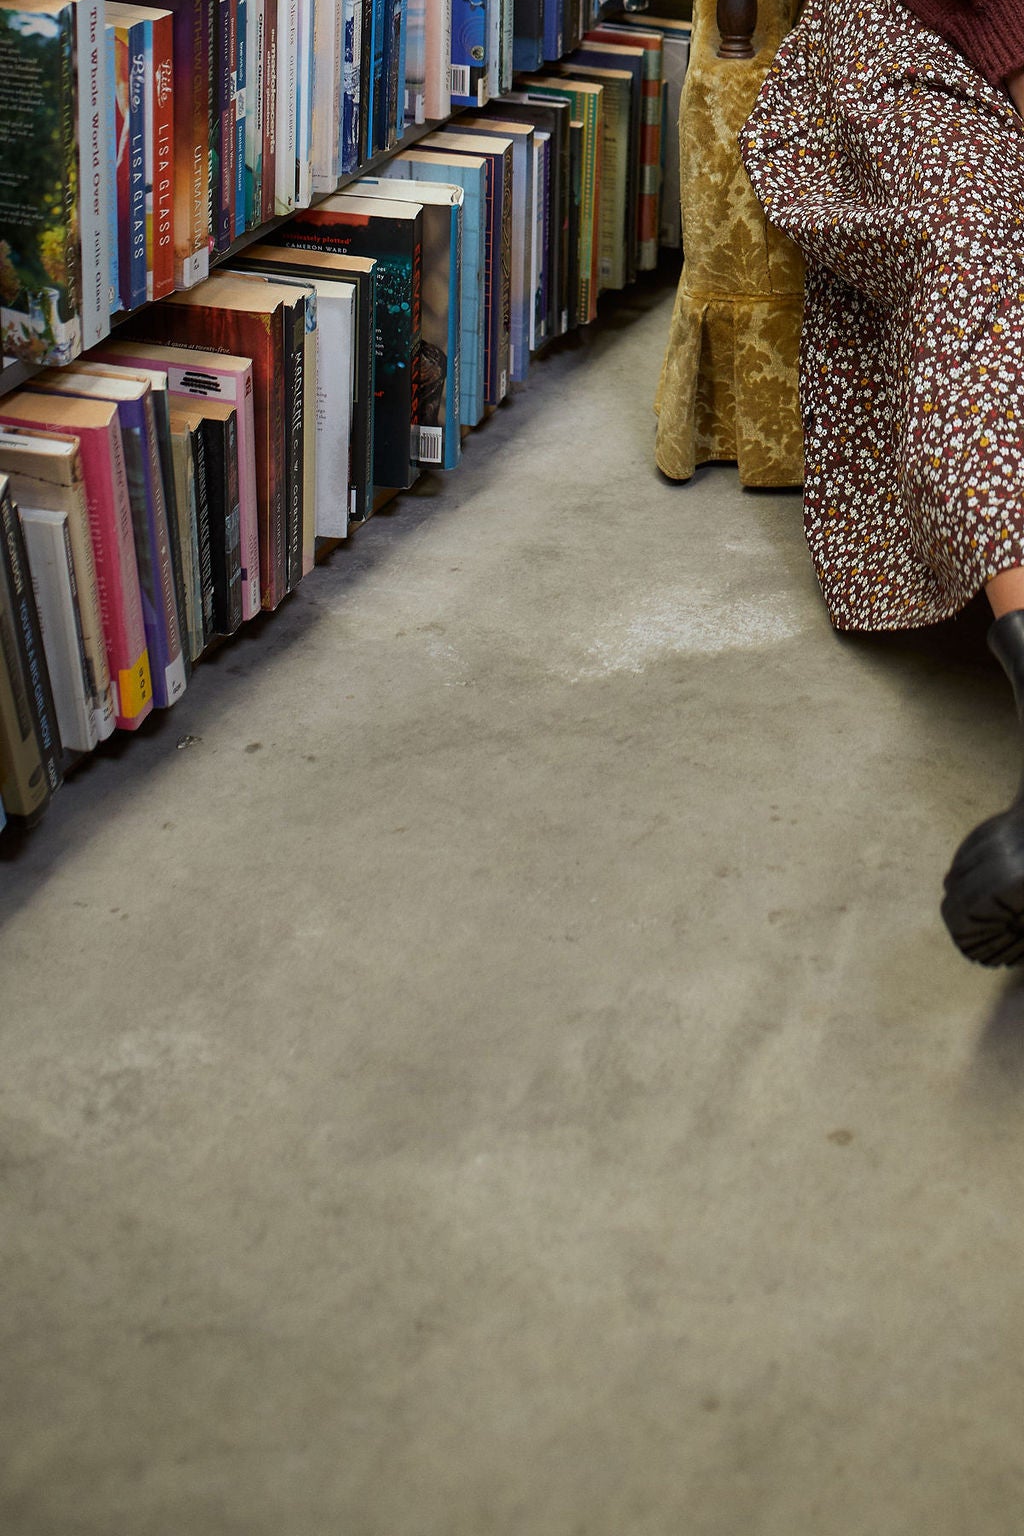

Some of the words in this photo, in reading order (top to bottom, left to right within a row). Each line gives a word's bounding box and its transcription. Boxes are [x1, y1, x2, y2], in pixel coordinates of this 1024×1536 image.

[90, 48, 99, 106] Whole
[131, 54, 145, 113] Blue
[155, 60, 172, 107] Ride
[92, 112, 100, 169] World
[132, 134, 142, 184] LISA
[158, 124, 169, 172] LISA
[93, 173, 101, 216] Over
[159, 179, 170, 247] GLASS
[194, 145, 202, 249] ULTIMATUM
[94, 230, 102, 266] Julia
[133, 191, 144, 260] GLASS
[286, 242, 323, 251] CAMERON
[325, 246, 348, 254] WARD
[0, 500, 11, 531] NEIL
[6, 533, 23, 596] GORDON
[20, 600, 33, 646] YOU'RE
[27, 649, 34, 658] A
[29, 662, 40, 686] BIG
[33, 687, 45, 714] GIRL
[39, 717, 52, 751] NOW
